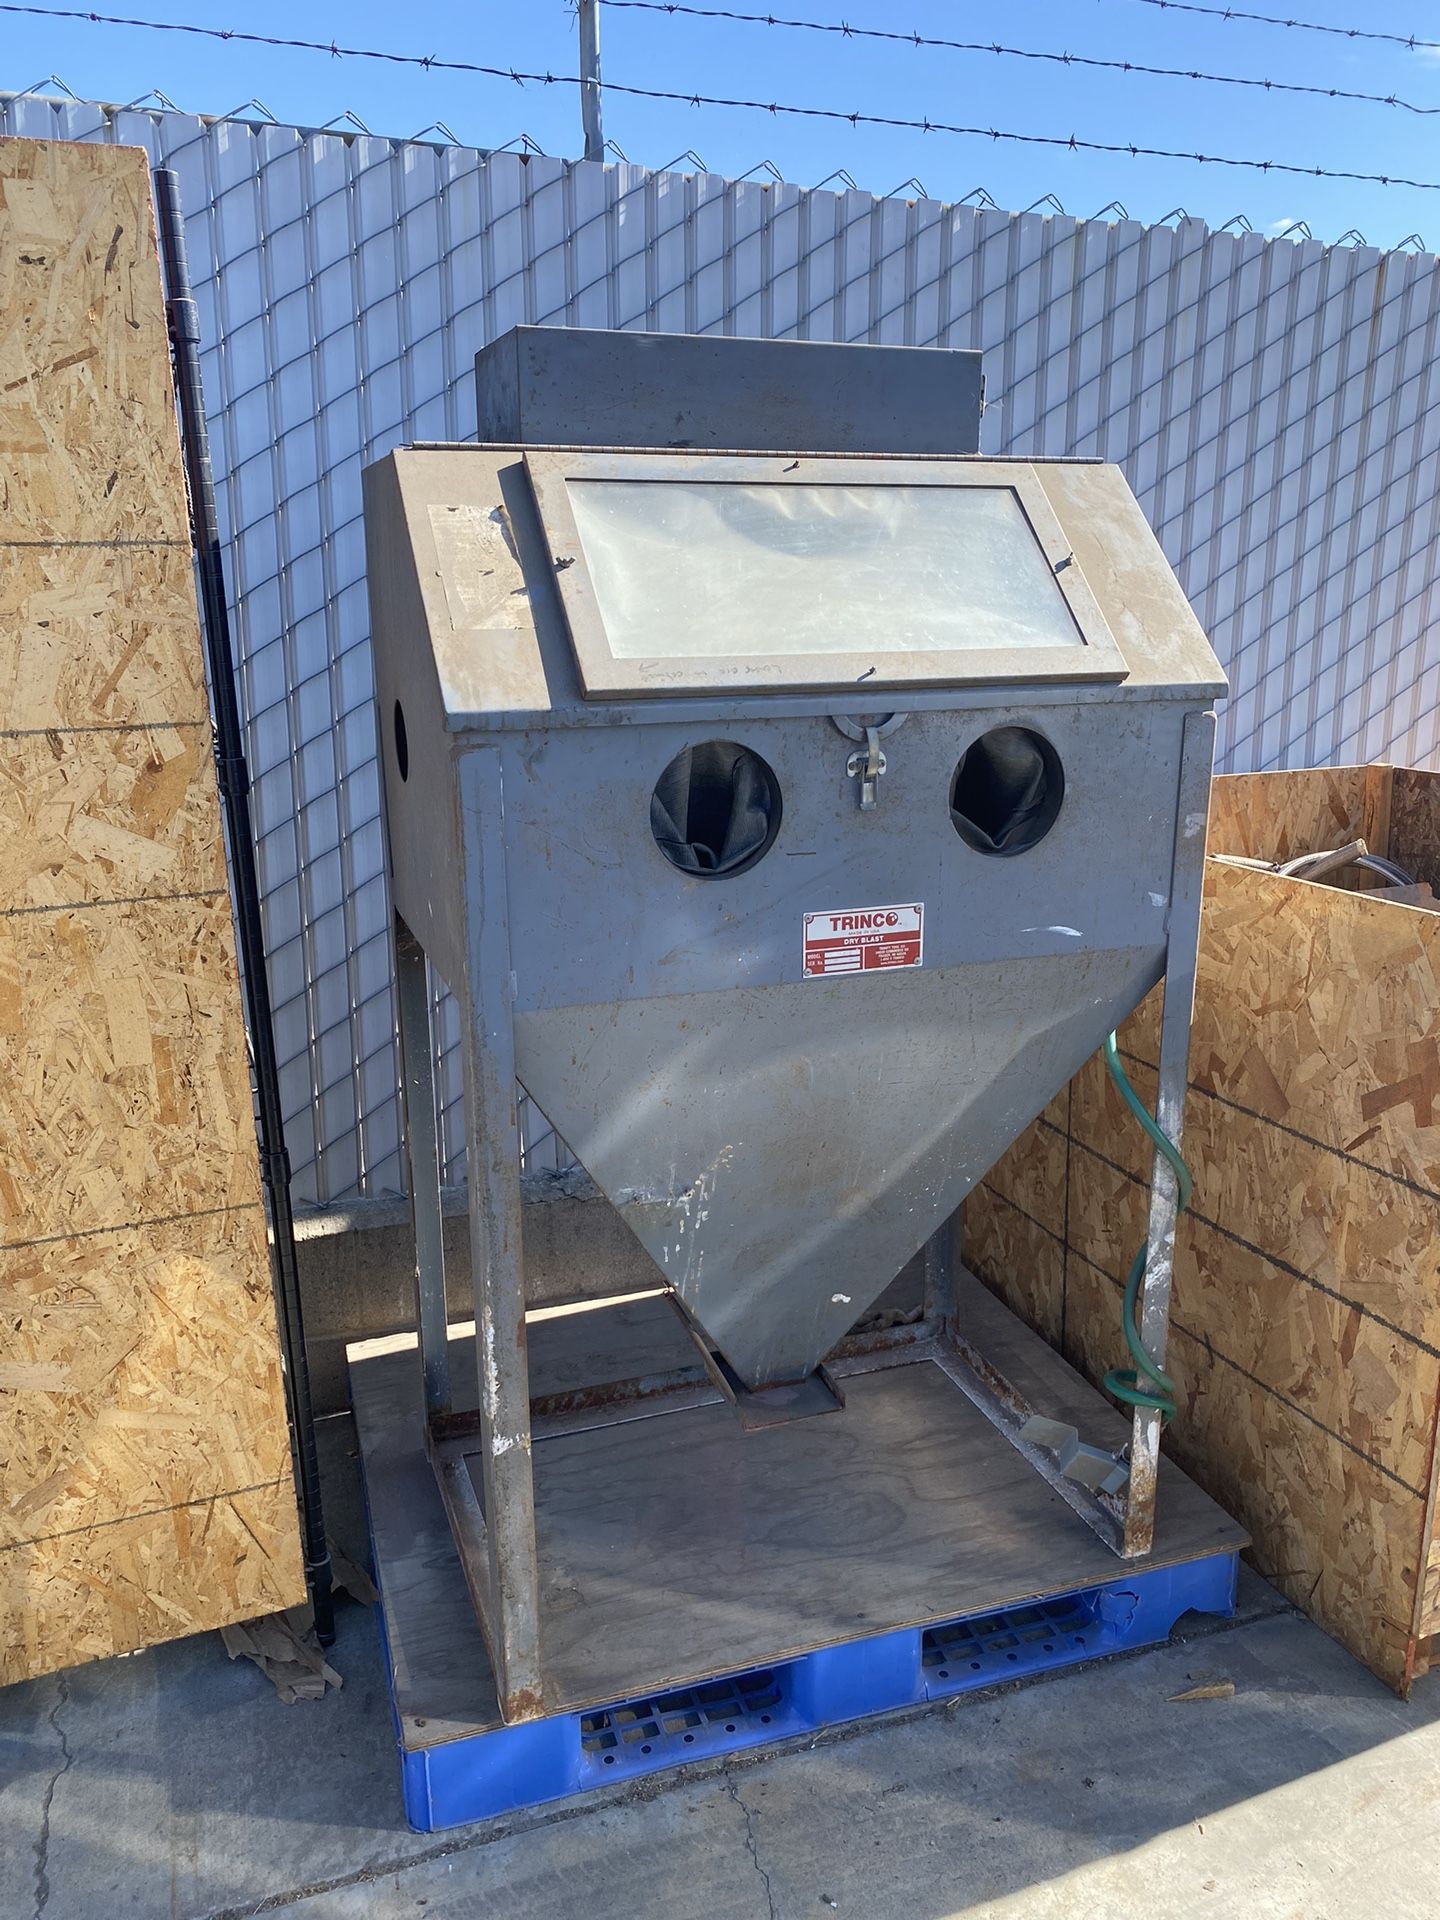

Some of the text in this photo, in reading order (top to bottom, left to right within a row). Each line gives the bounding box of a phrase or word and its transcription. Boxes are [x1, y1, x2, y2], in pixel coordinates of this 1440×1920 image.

[829, 911, 899, 931] TRINCO
[844, 935, 884, 945] DRY BLAST
